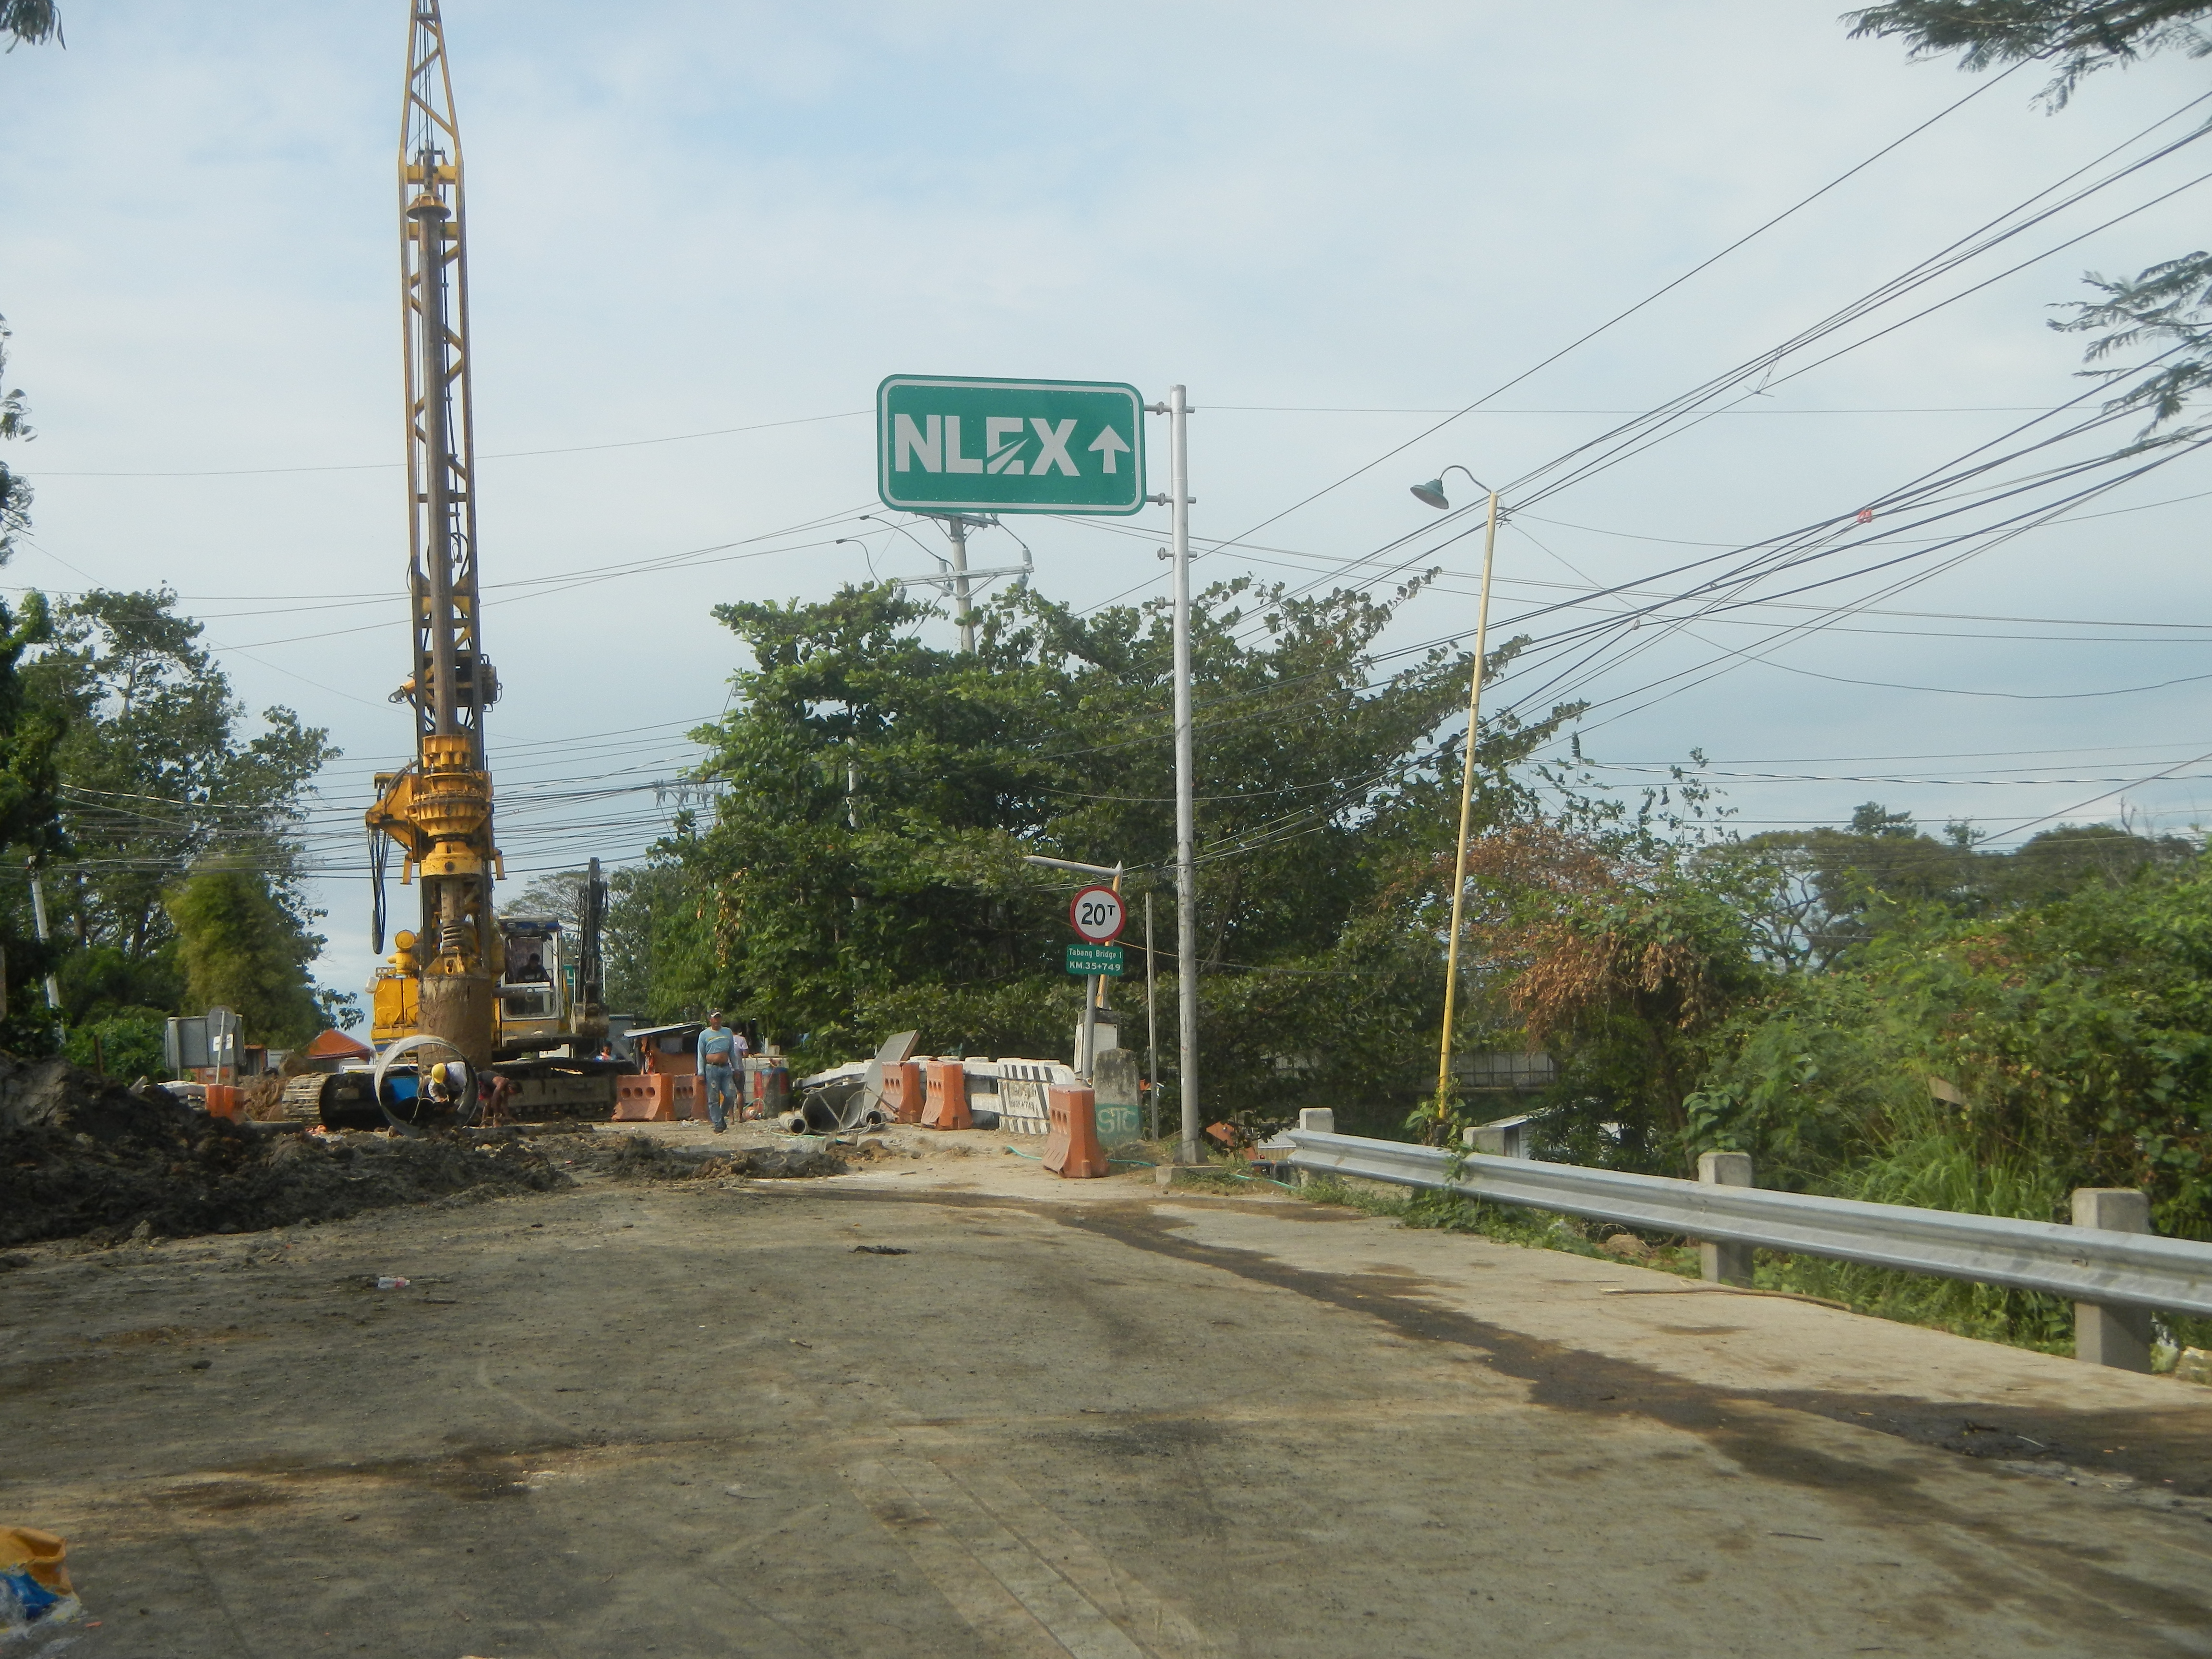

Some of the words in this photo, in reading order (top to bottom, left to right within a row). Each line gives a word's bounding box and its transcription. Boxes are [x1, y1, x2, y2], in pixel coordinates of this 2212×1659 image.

[895, 414, 1080, 476] NLEX
[1069, 948, 1093, 959] Tabang
[1095, 950, 1117, 960] Bridge
[1069, 961, 1121, 971] KM.35+749
